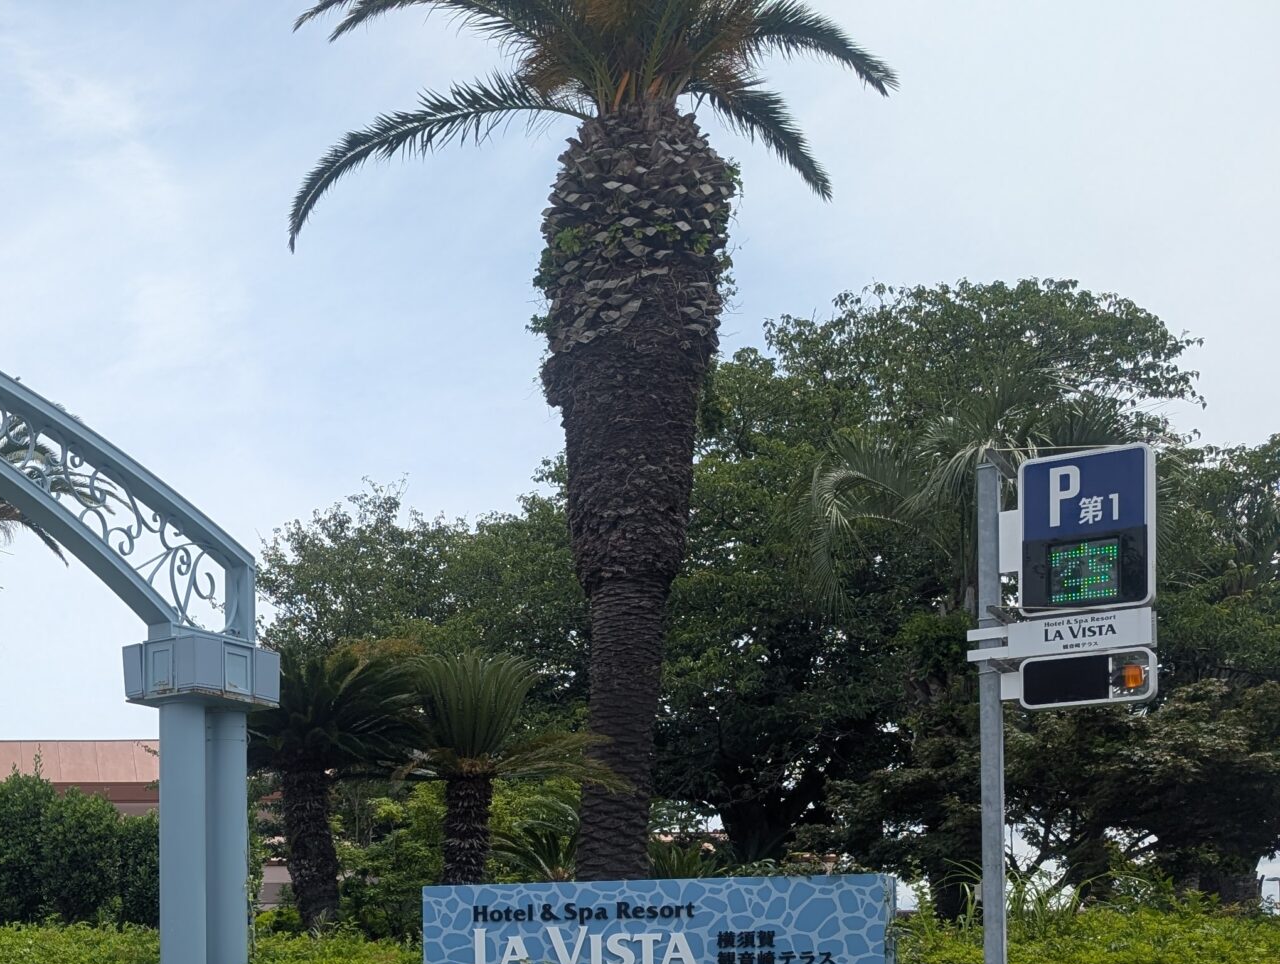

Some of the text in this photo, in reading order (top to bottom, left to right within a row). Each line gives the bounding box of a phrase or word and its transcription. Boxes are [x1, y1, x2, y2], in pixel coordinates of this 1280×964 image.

[1049, 465, 1120, 528] P 第1
[1052, 543, 1117, 602] 空
[1044, 624, 1117, 642] LA VISTA
[473, 901, 695, 925] Hotel & Spa Resort
[717, 930, 776, 949] 横須賀
